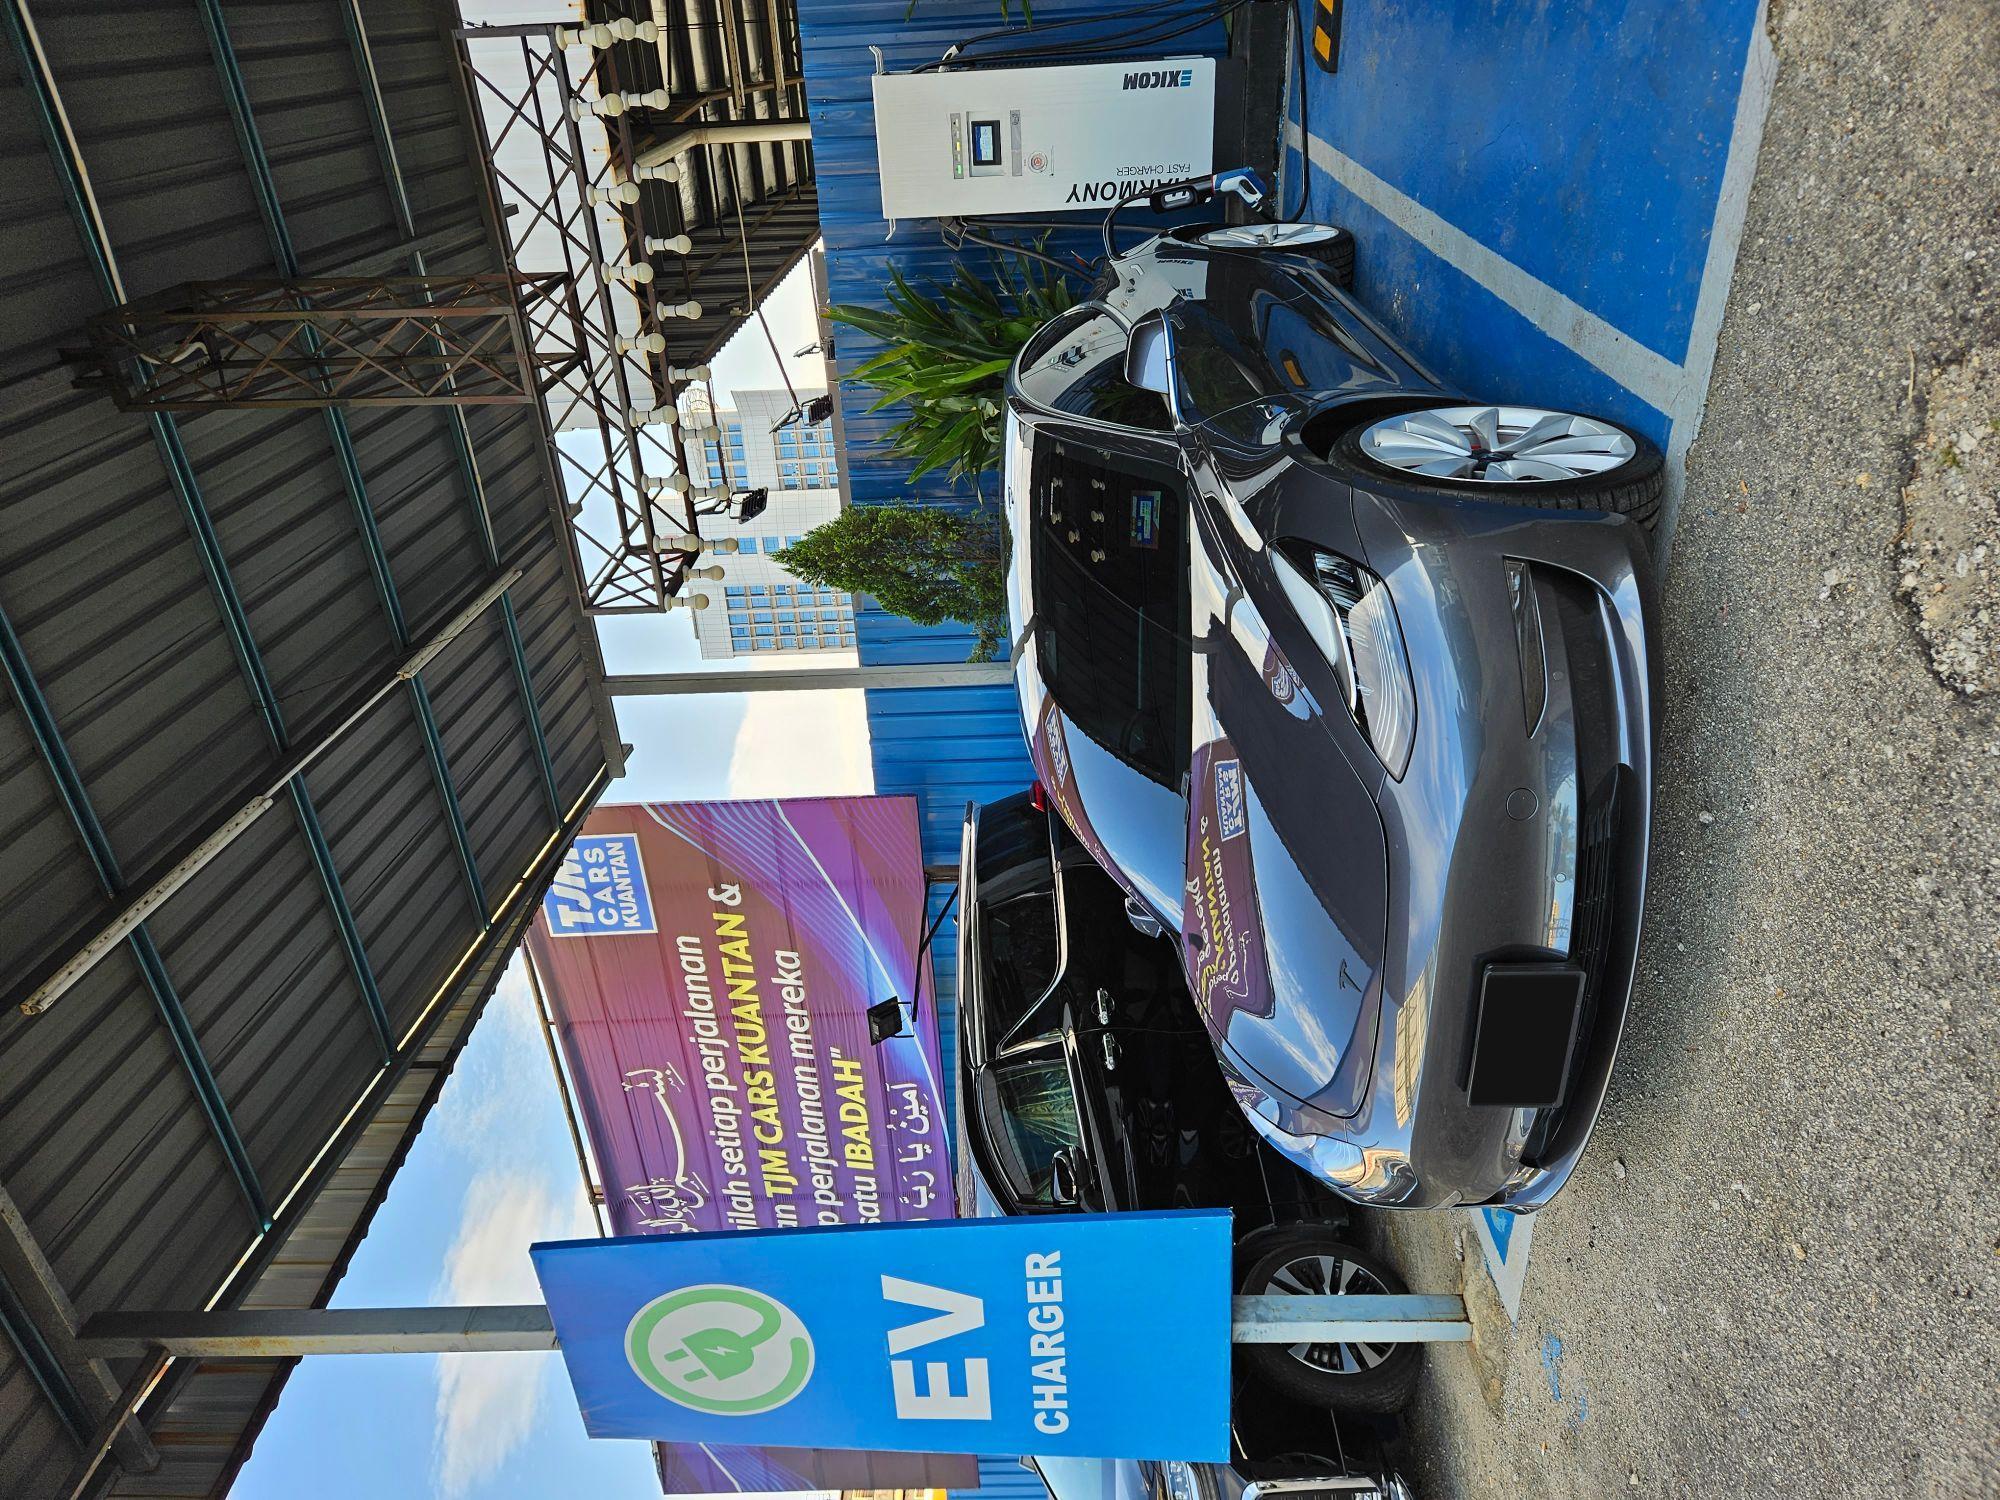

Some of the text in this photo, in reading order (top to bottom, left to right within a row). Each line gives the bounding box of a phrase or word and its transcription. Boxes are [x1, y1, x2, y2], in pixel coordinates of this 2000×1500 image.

[1122, 69, 1192, 90] EXICOM
[1065, 177, 1190, 203] RMONY
[1116, 163, 1191, 176] FAST CHARGER
[552, 847, 595, 927] TJM
[583, 847, 619, 926] CARS
[606, 842, 641, 928] KUANTAN
[707, 883, 742, 906] &
[675, 935, 737, 1091] perjalanan
[712, 912, 770, 1065] KUANTAN
[770, 949, 814, 1059] mereka
[709, 1097, 742, 1175] setiap
[743, 1070, 783, 1144] CARS
[793, 1065, 844, 1207] perjalanan
[758, 1149, 799, 1198] TJM
[880, 1274, 992, 1421] EV
[1025, 1250, 1070, 1435] CHARGER
